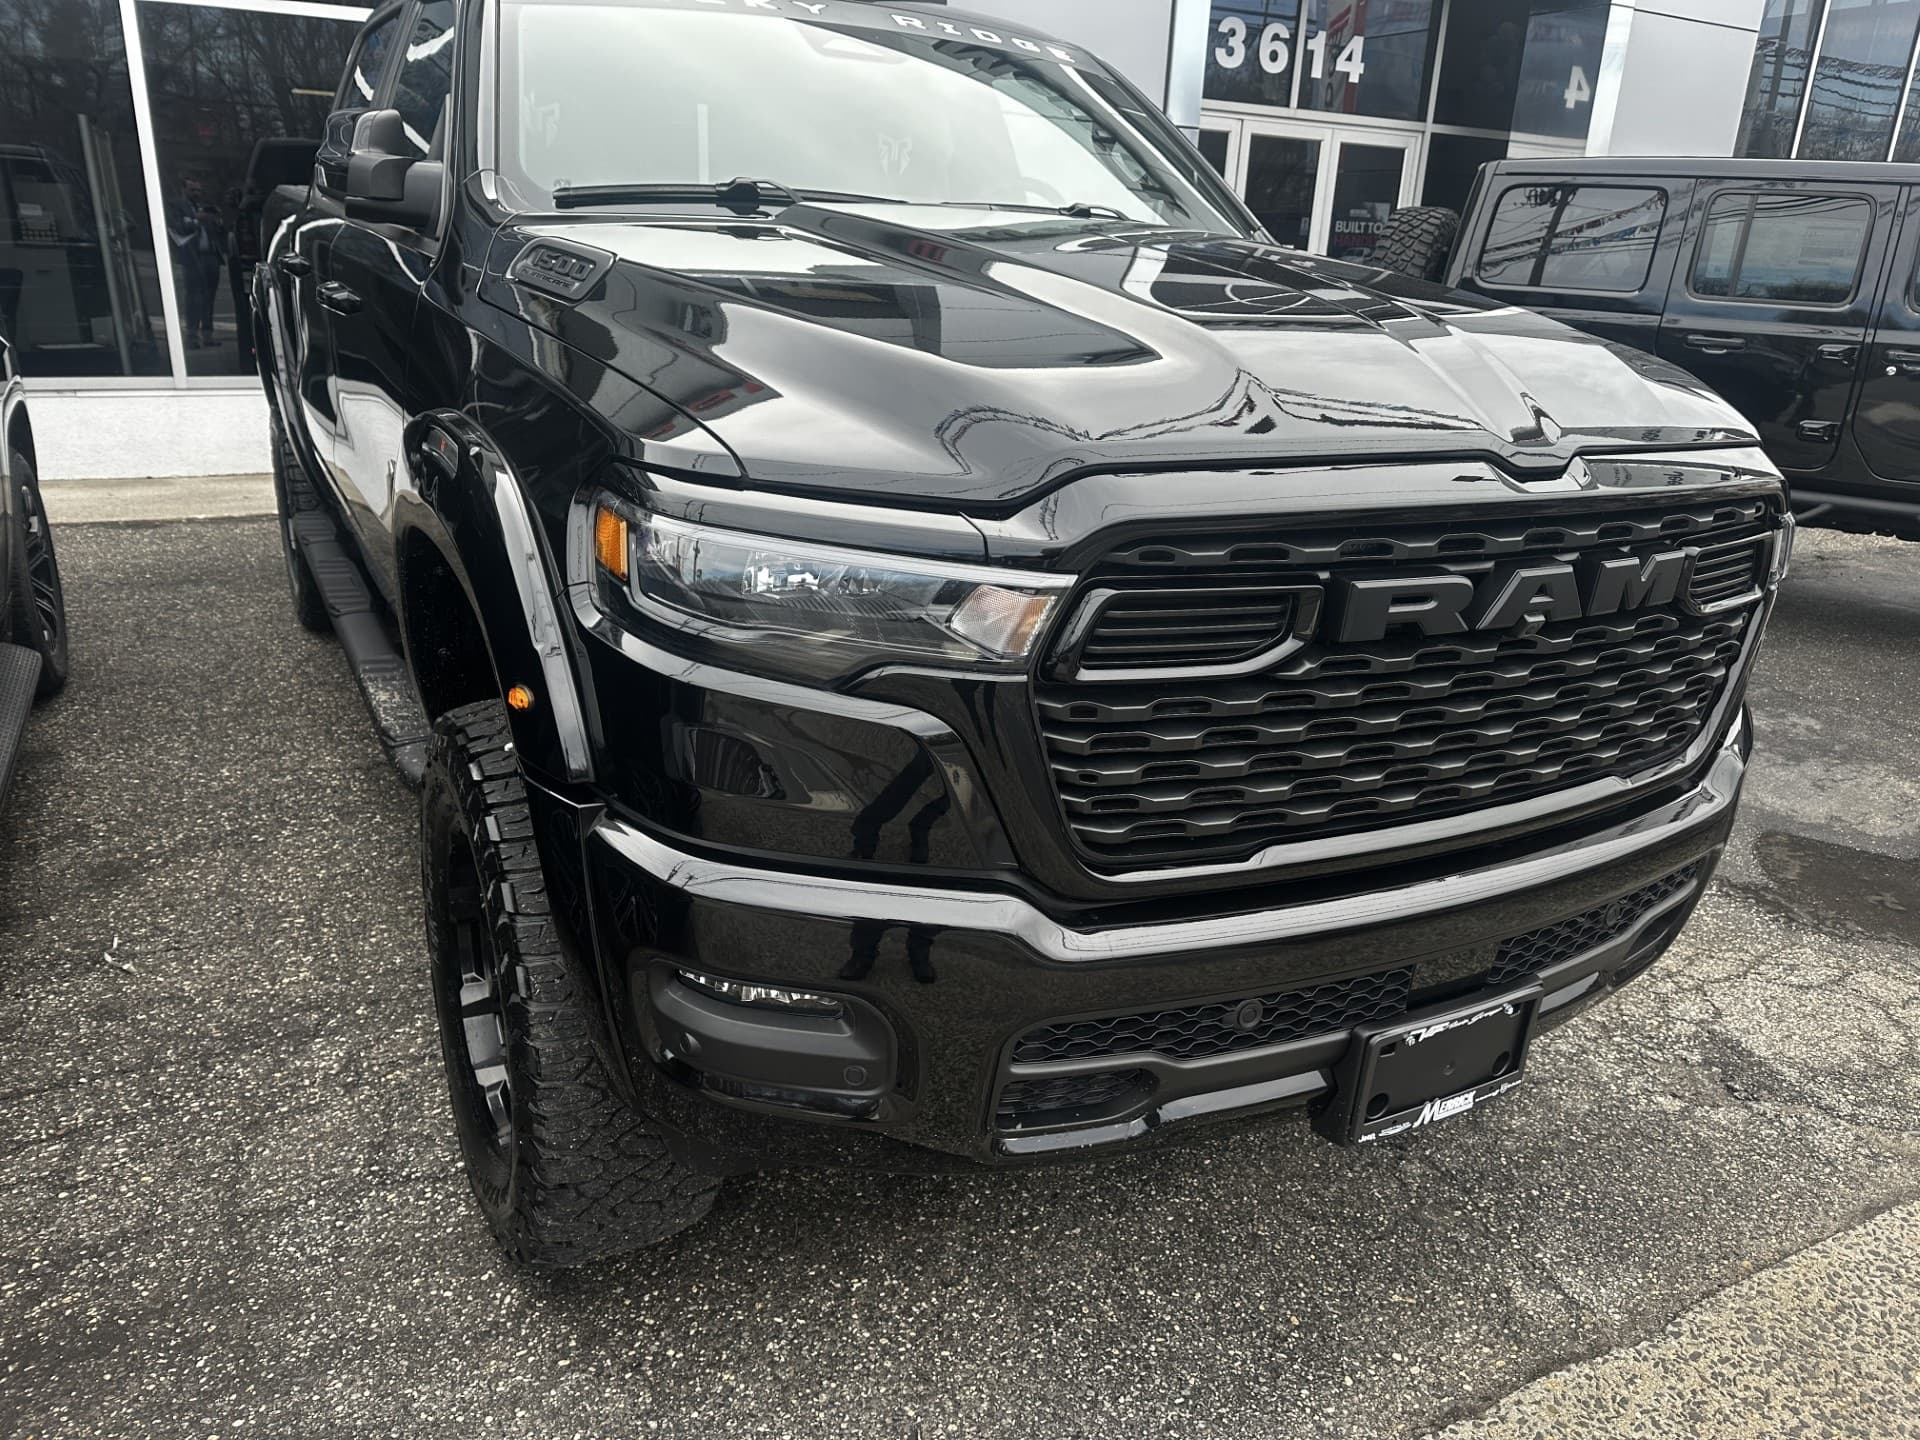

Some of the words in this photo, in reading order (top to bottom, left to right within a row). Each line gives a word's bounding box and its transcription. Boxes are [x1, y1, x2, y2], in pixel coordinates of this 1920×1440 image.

[891, 14, 1075, 63] RIDGE
[1215, 16, 1365, 84] 3614
[1335, 220, 1366, 234] BUILT
[1367, 221, 1383, 234] TO
[533, 249, 595, 281] 1500
[1339, 551, 1686, 642] RAM
